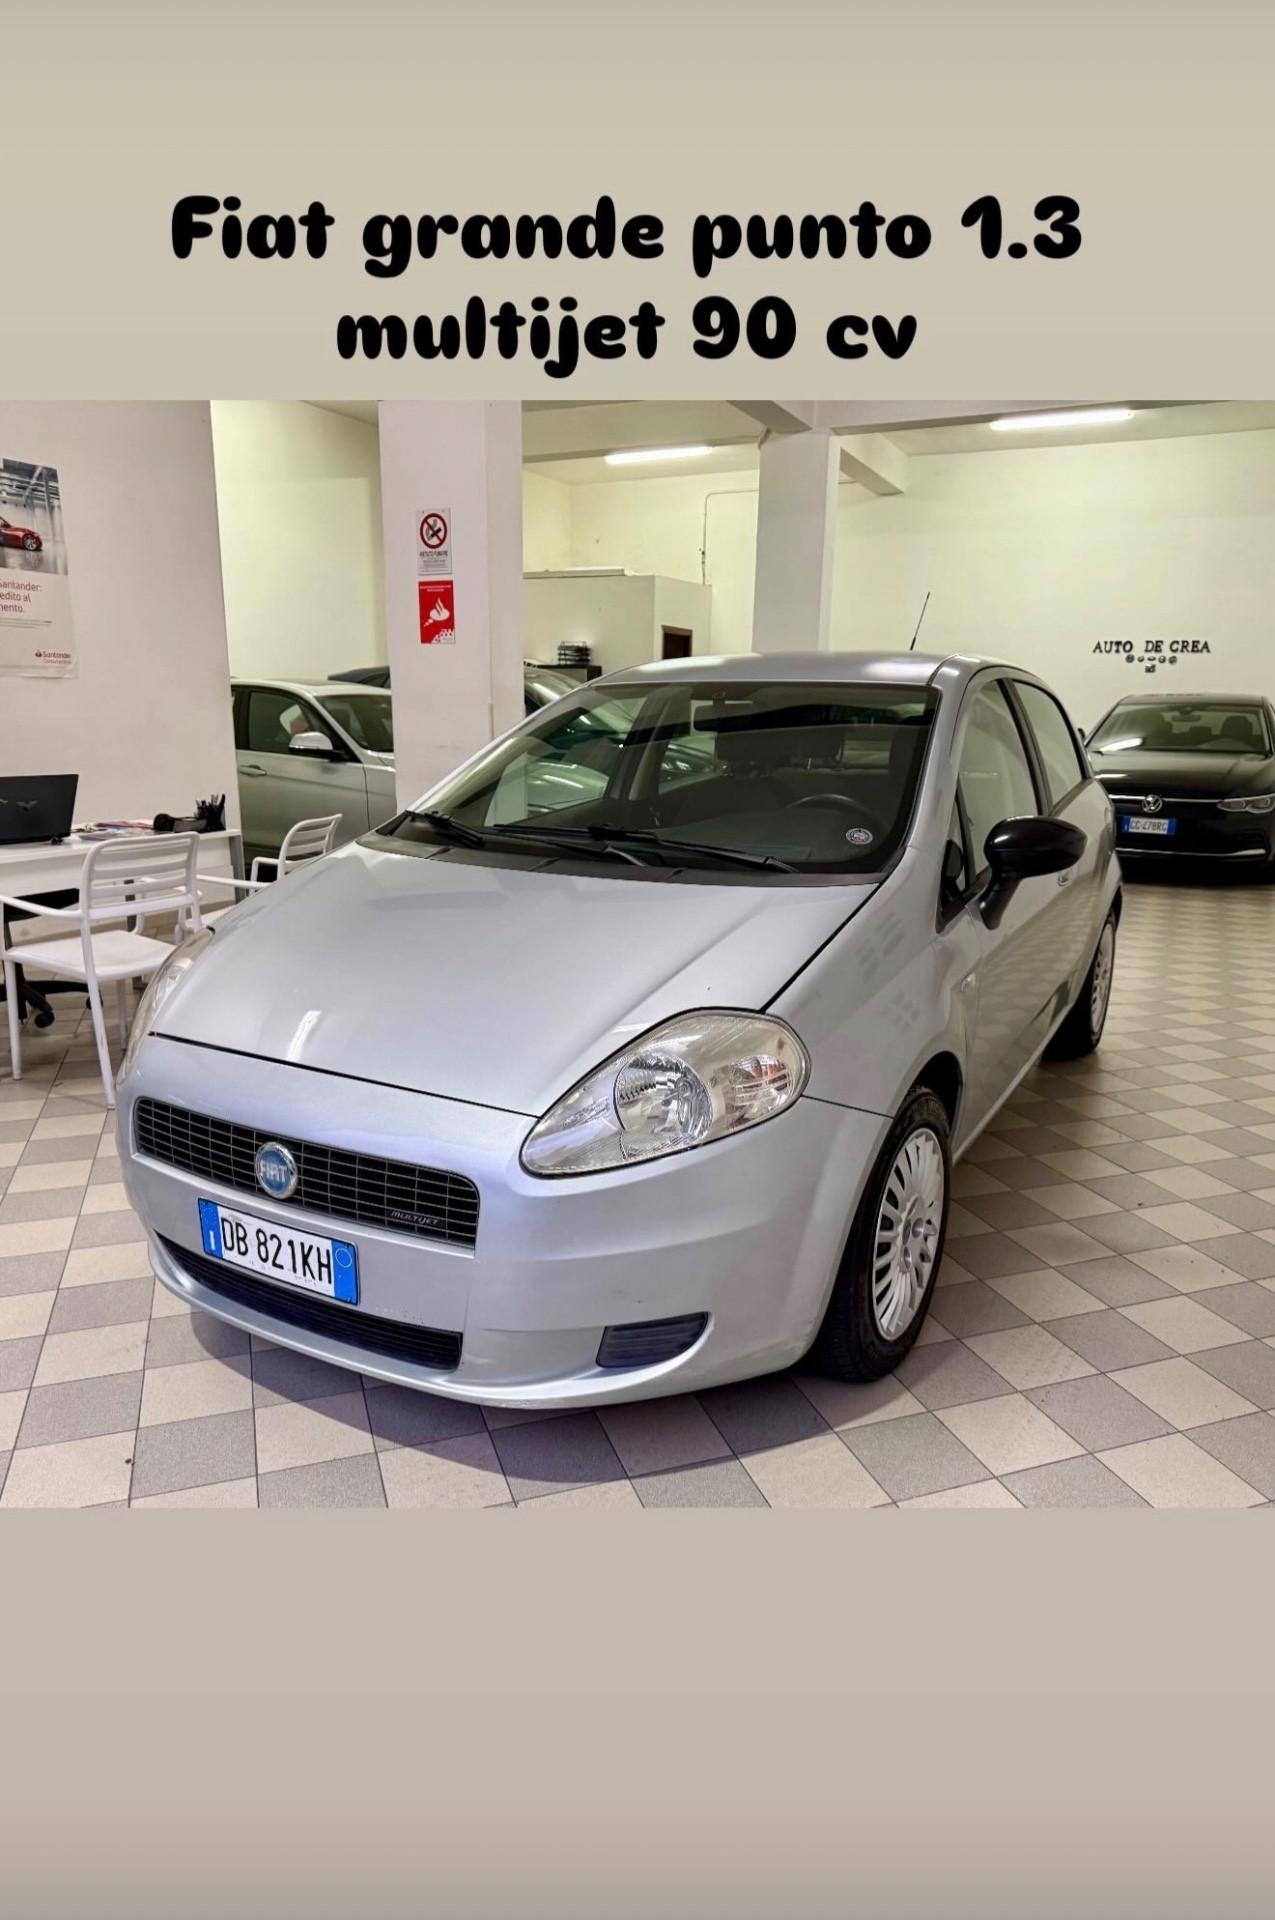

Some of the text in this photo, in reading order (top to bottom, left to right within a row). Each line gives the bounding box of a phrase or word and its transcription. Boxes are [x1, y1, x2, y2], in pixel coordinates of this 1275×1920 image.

[1093, 640, 1211, 654] AUTO DE CREA
[260, 1160, 288, 1184] FIAT
[220, 1216, 332, 1285] DB 821KH
